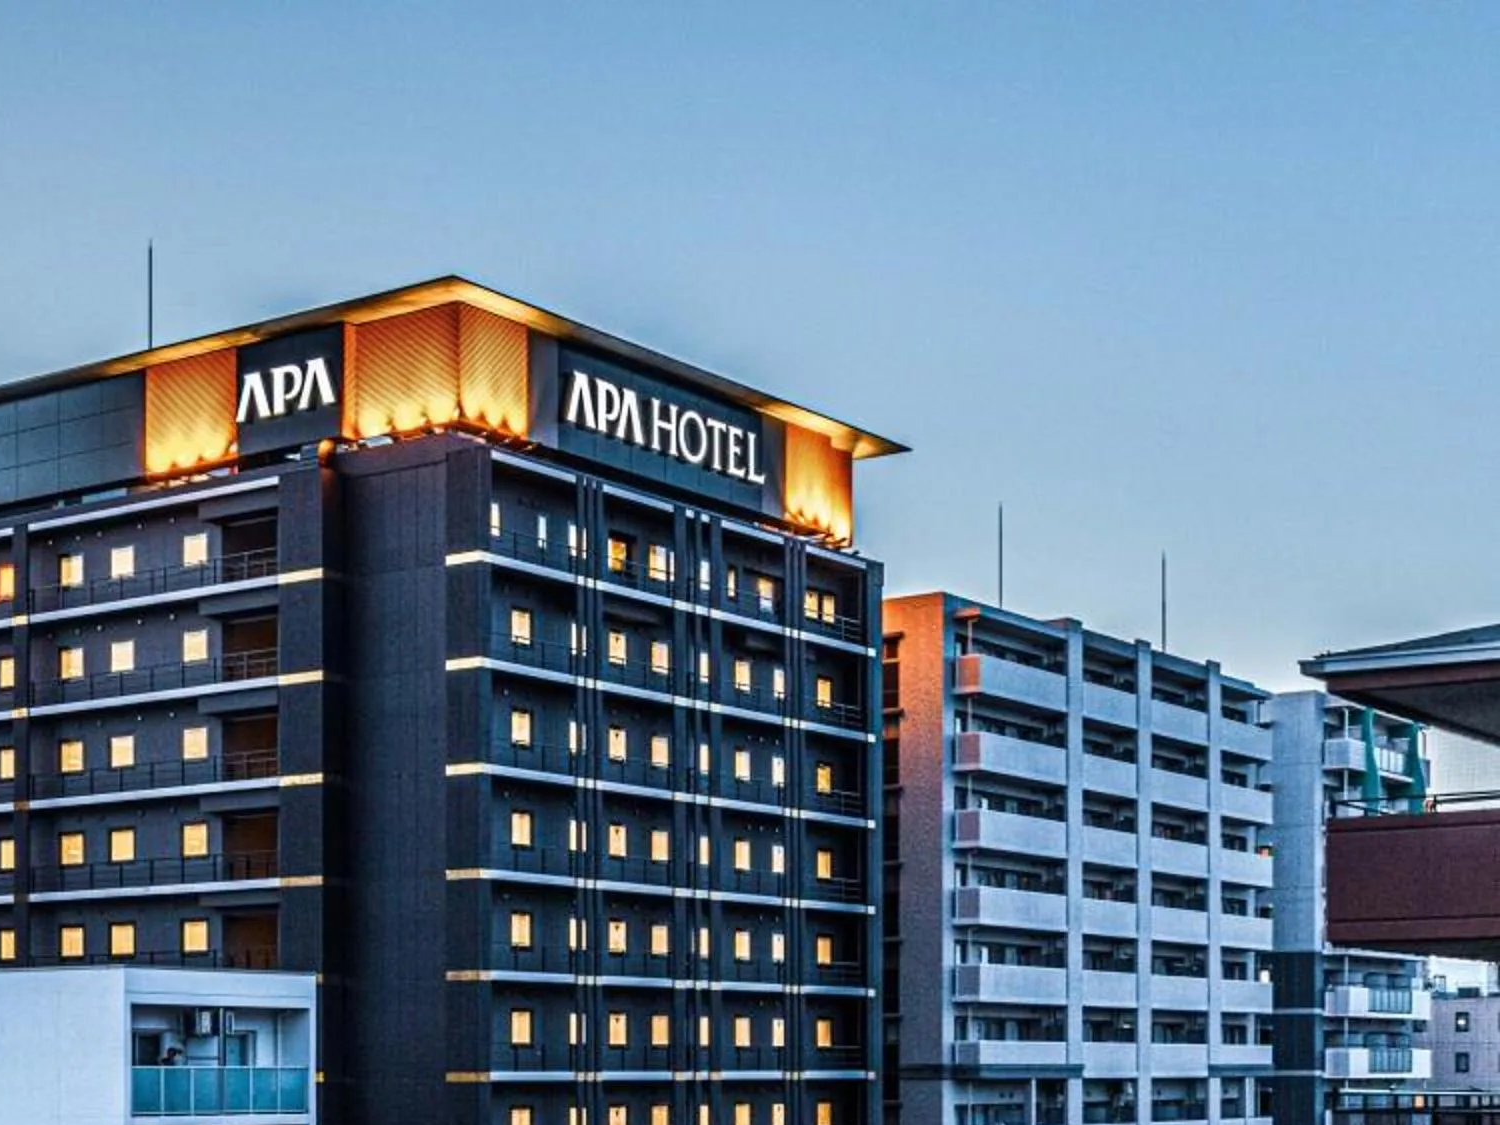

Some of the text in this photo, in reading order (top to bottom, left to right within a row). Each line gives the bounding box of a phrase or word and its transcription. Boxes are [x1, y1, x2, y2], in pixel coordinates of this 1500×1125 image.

[236, 357, 337, 423] APA
[566, 371, 767, 485] APA HOTEL
